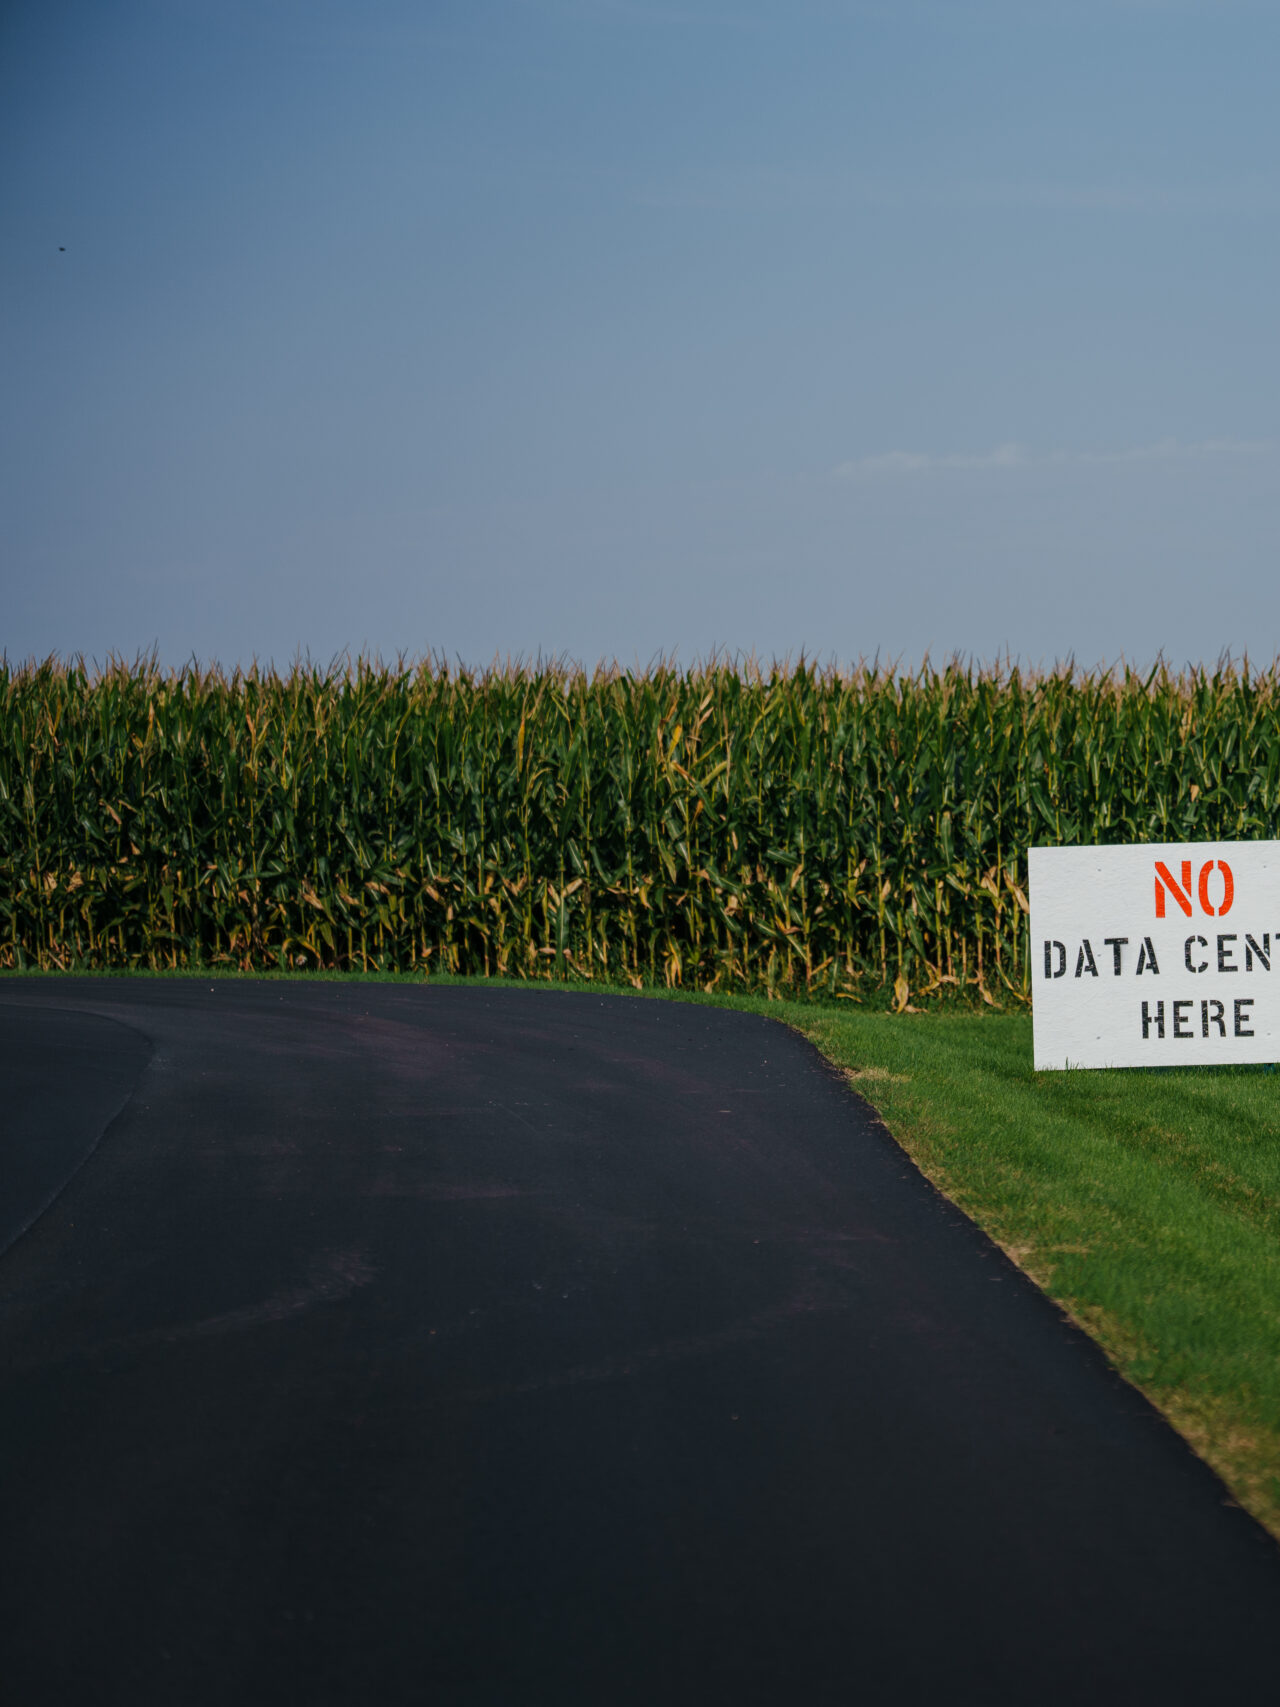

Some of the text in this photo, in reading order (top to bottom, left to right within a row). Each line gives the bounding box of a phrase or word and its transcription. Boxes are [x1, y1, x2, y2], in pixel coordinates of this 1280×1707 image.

[1154, 859, 1234, 918] NO
[1044, 936, 1160, 979] DATA
[1141, 998, 1255, 1039] HERE
